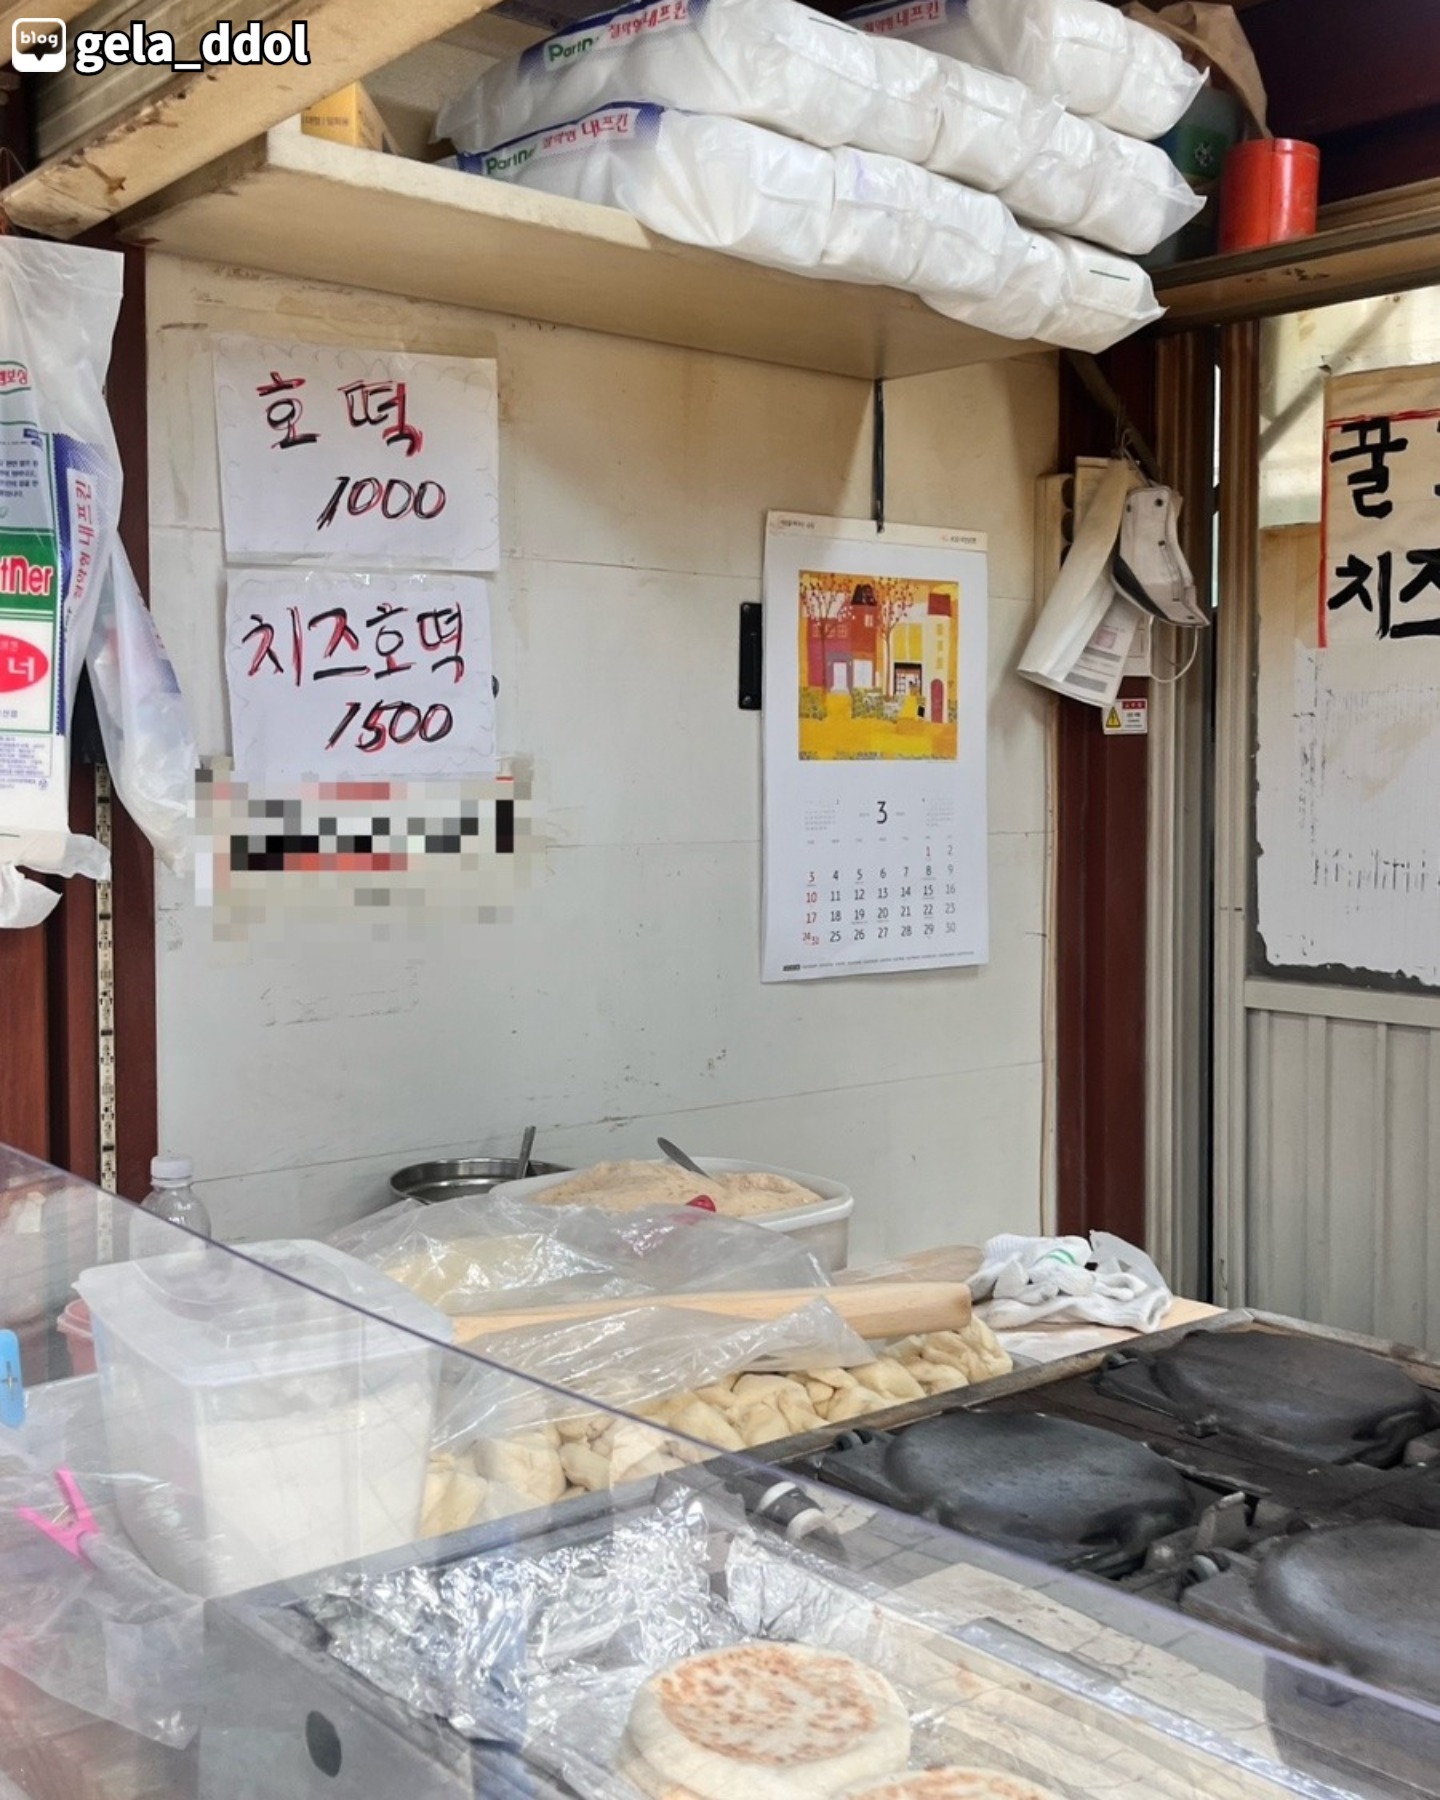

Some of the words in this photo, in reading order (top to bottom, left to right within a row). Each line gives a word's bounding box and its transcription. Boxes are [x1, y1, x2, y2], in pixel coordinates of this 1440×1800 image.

[317, 476, 446, 530] 1000
[242, 601, 465, 687] 치즈호떡
[324, 700, 454, 754] 1500
[876, 801, 888, 824] 3
[947, 845, 953, 856] 2
[808, 871, 816, 883] 3
[832, 870, 839, 880] 4
[856, 868, 863, 880] 5
[880, 868, 886, 879] 6
[903, 866, 909, 877] 7
[925, 865, 932, 876] 8
[947, 864, 954, 874] 9
[806, 892, 817, 903] 10
[830, 890, 840, 901] 11
[854, 889, 865, 900] 12
[877, 888, 888, 899] 13
[900, 886, 911, 897] 14
[923, 885, 933, 896] 15
[945, 883, 956, 894] 16
[806, 912, 816, 924] 17
[830, 910, 841, 922] 18
[854, 909, 865, 920] 19
[877, 907, 888, 918] 20
[900, 906, 911, 917] 21
[923, 904, 933, 915] 22
[830, 931, 841, 942] 25
[854, 929, 865, 941] 26
[877, 927, 888, 938] 27
[900, 925, 912, 937] 28
[923, 923, 934, 935] 29
